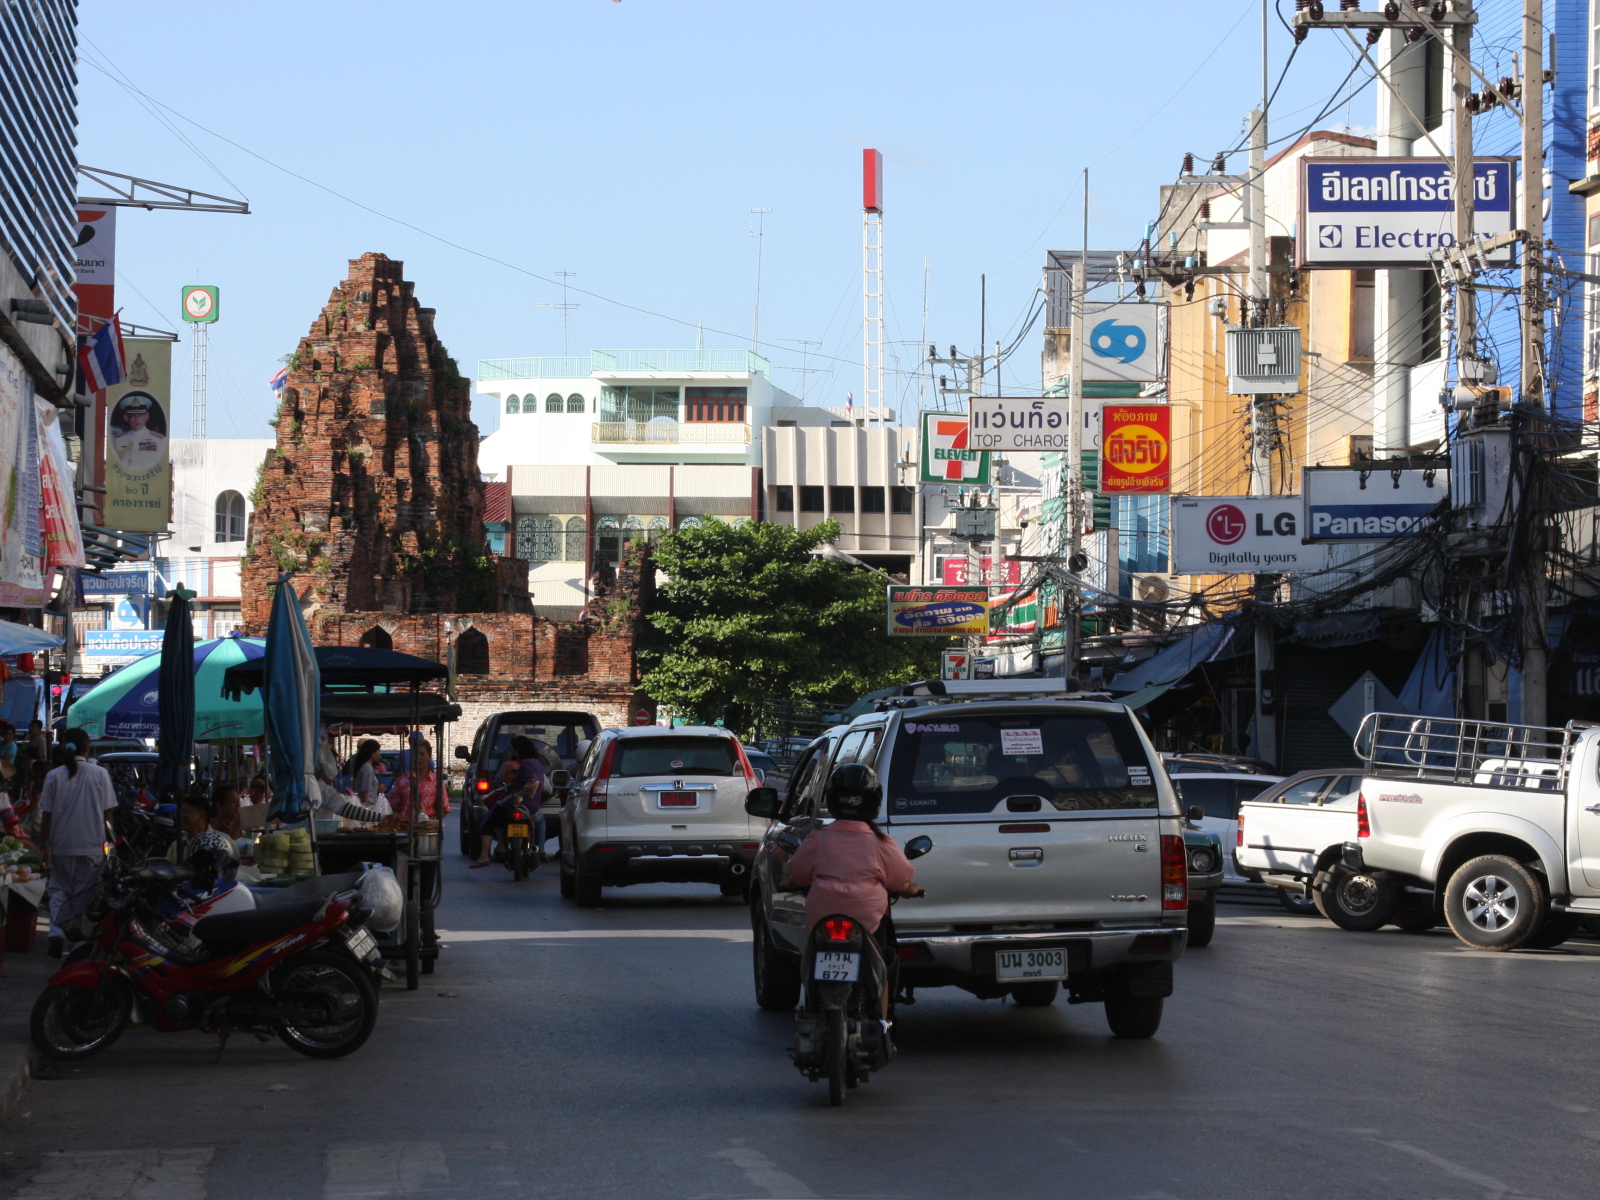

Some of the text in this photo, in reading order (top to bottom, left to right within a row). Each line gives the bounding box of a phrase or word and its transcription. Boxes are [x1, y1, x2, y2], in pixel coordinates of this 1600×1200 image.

[1322, 170, 1498, 201] อีเลคโทรลัซ์
[1355, 226, 1497, 249] Electro
[975, 402, 1098, 429] แว่นท็อเ
[1113, 408, 1158, 422] ห้องภาพ
[975, 434, 1070, 447] TOP CHAROE
[936, 420, 968, 480] 7
[1109, 433, 1162, 465] ดีจริง
[112, 463, 162, 481] ทรงพระเจริญ
[141, 483, 149, 494] ปี
[112, 498, 161, 508] ครองราชย์
[1256, 512, 1296, 536] LG
[1313, 512, 1440, 535] Panason
[1209, 552, 1297, 566] Digitally yours
[893, 589, 987, 601] เมโทร ดิจิตอล
[904, 607, 953, 619] อัดภาพ
[893, 626, 914, 634] ถ่ายรูป
[949, 655, 966, 680] 7
[1109, 834, 1147, 842] HILUX
[1134, 843, 1148, 852] E
[824, 952, 852, 962] กวม
[1000, 952, 1062, 968] บน 3003
[822, 970, 849, 980] 677
[1022, 969, 1042, 977] สระบุรี
